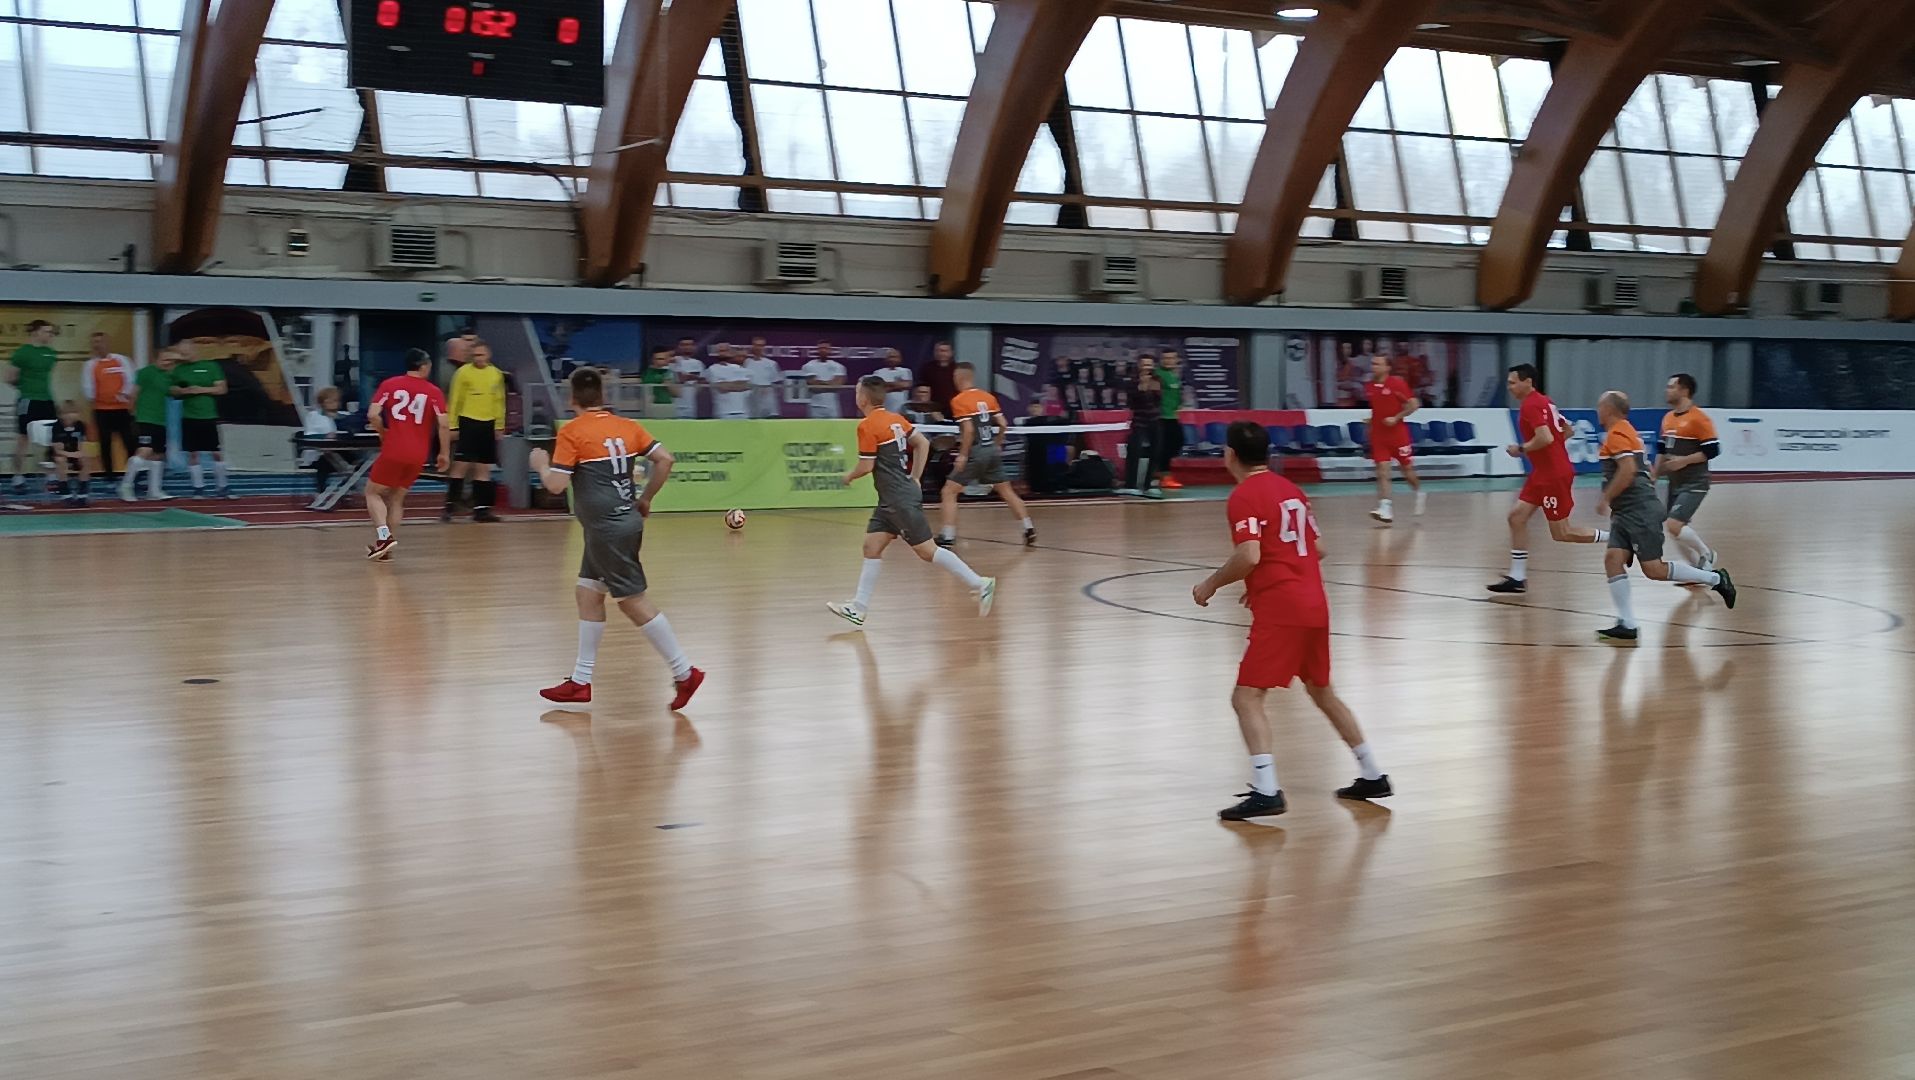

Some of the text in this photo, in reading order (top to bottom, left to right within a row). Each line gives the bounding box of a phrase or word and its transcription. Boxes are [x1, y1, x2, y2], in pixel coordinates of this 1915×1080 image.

[391, 390, 428, 424] 24
[603, 438, 628, 474] 11
[1543, 496, 1557, 509] 69
